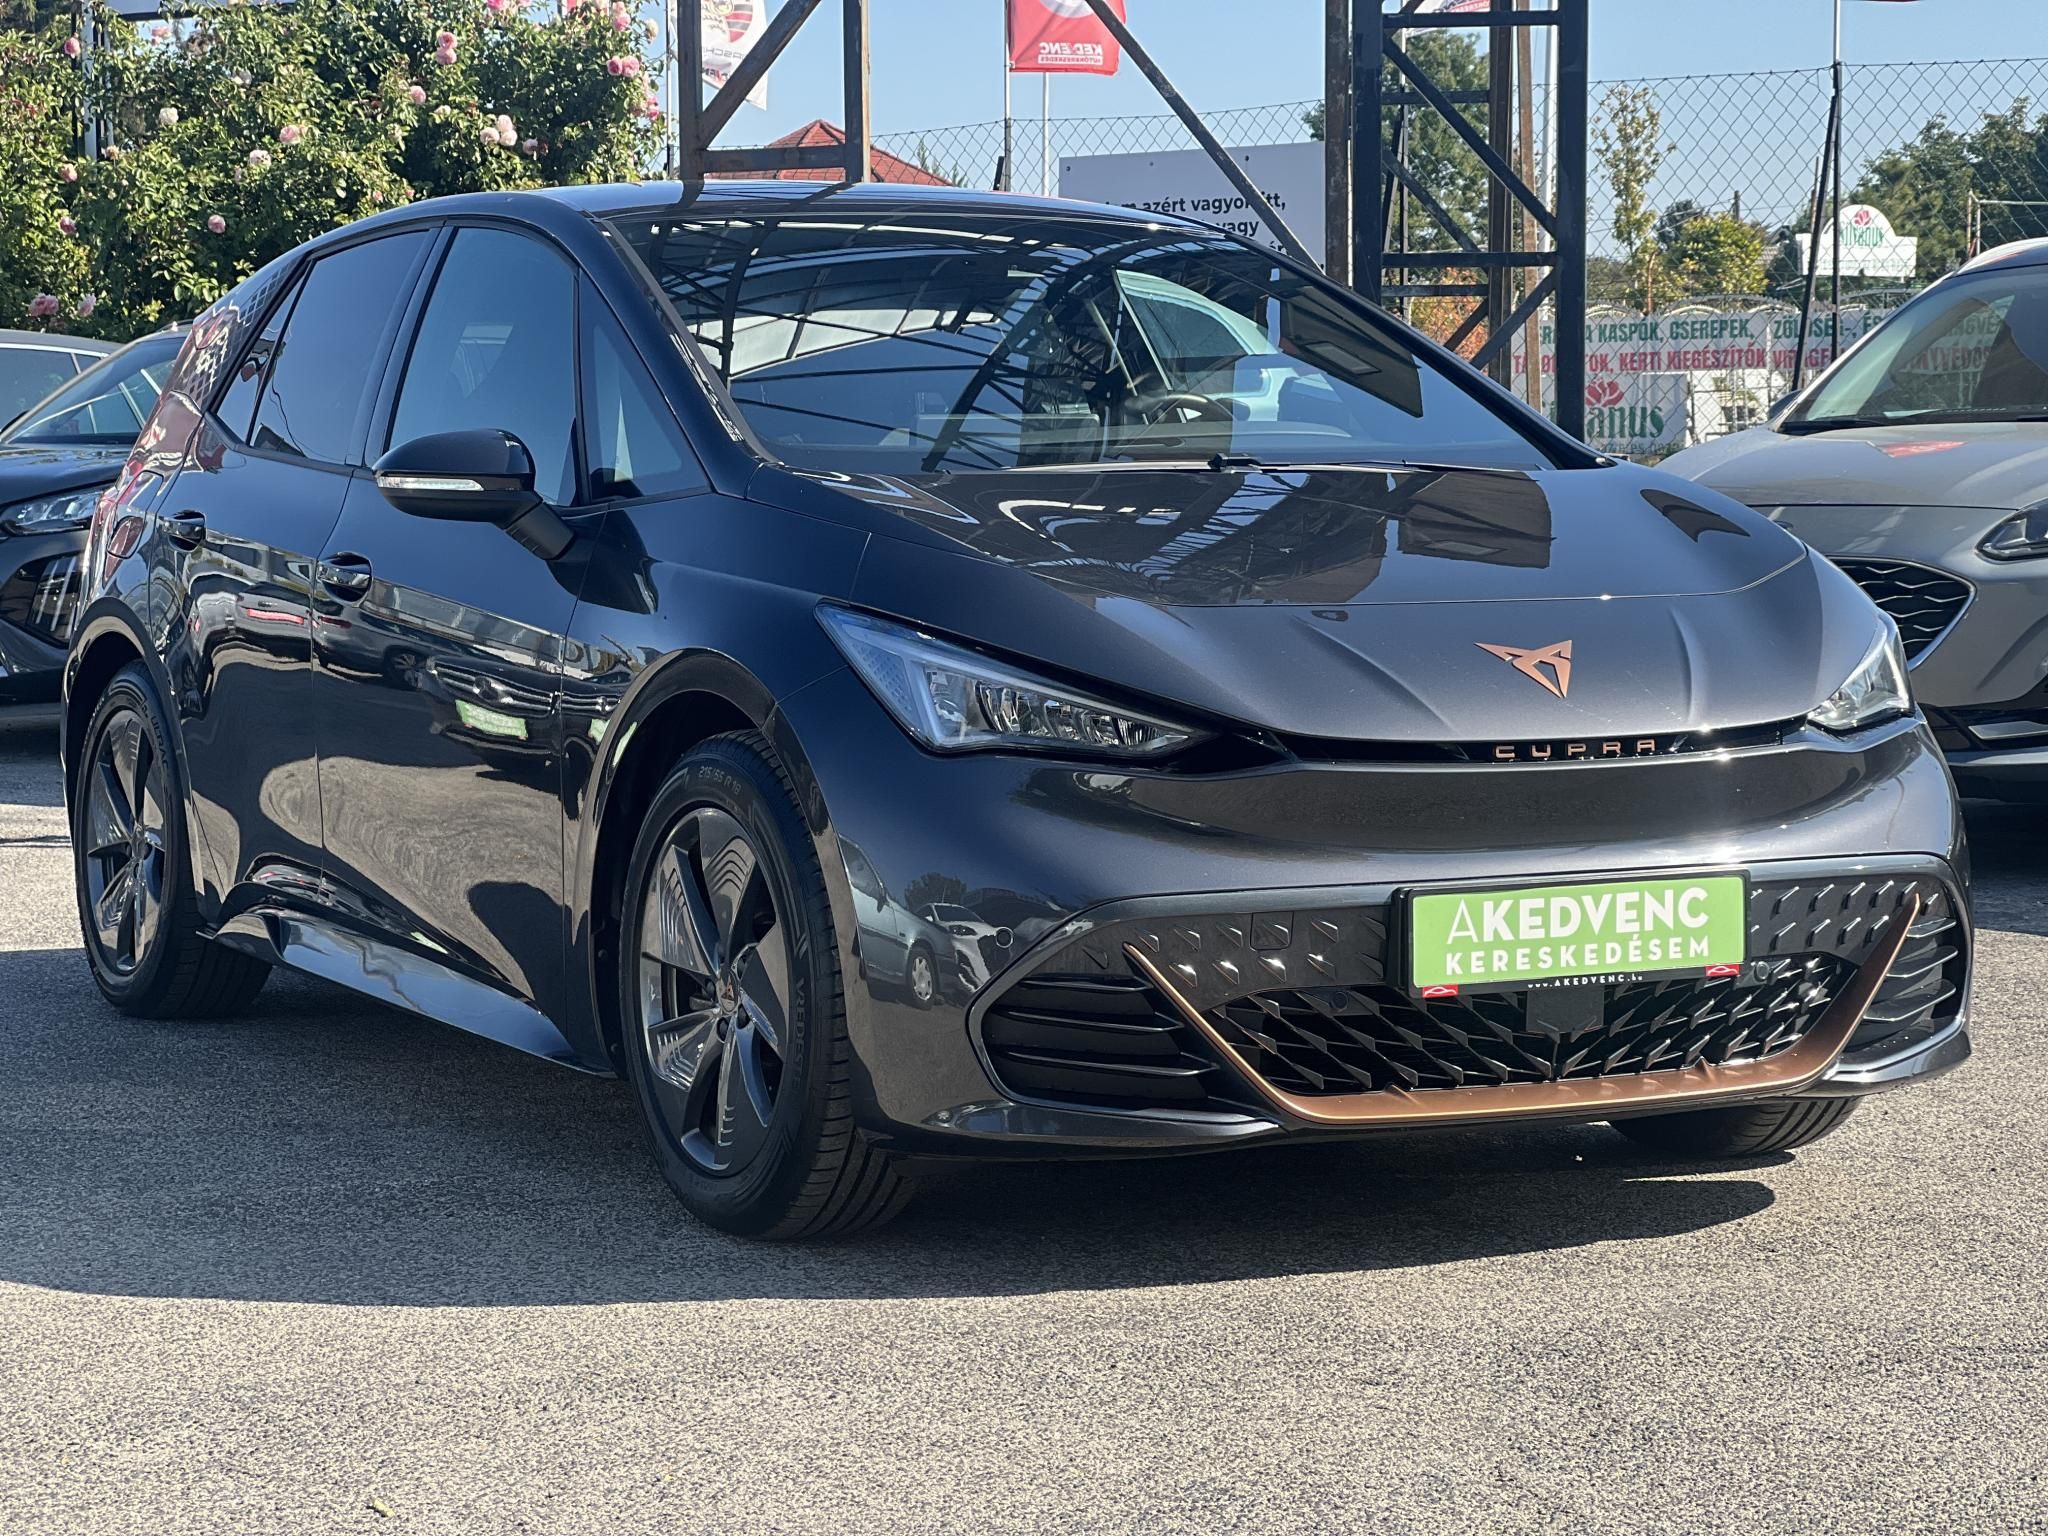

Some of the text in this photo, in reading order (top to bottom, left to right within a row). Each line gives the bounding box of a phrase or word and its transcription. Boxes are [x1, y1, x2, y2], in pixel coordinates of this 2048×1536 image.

[1142, 197, 1187, 213] azért
[1191, 197, 1250, 214] vagyo
[1669, 318, 1754, 341] CSEREPEK,
[1773, 315, 1858, 340] ZÖLSÉ-,
[1619, 352, 1662, 372] KERTI
[1495, 739, 1655, 759] CUPRA
[1445, 933, 1710, 976] KERESKEDÉSEM
